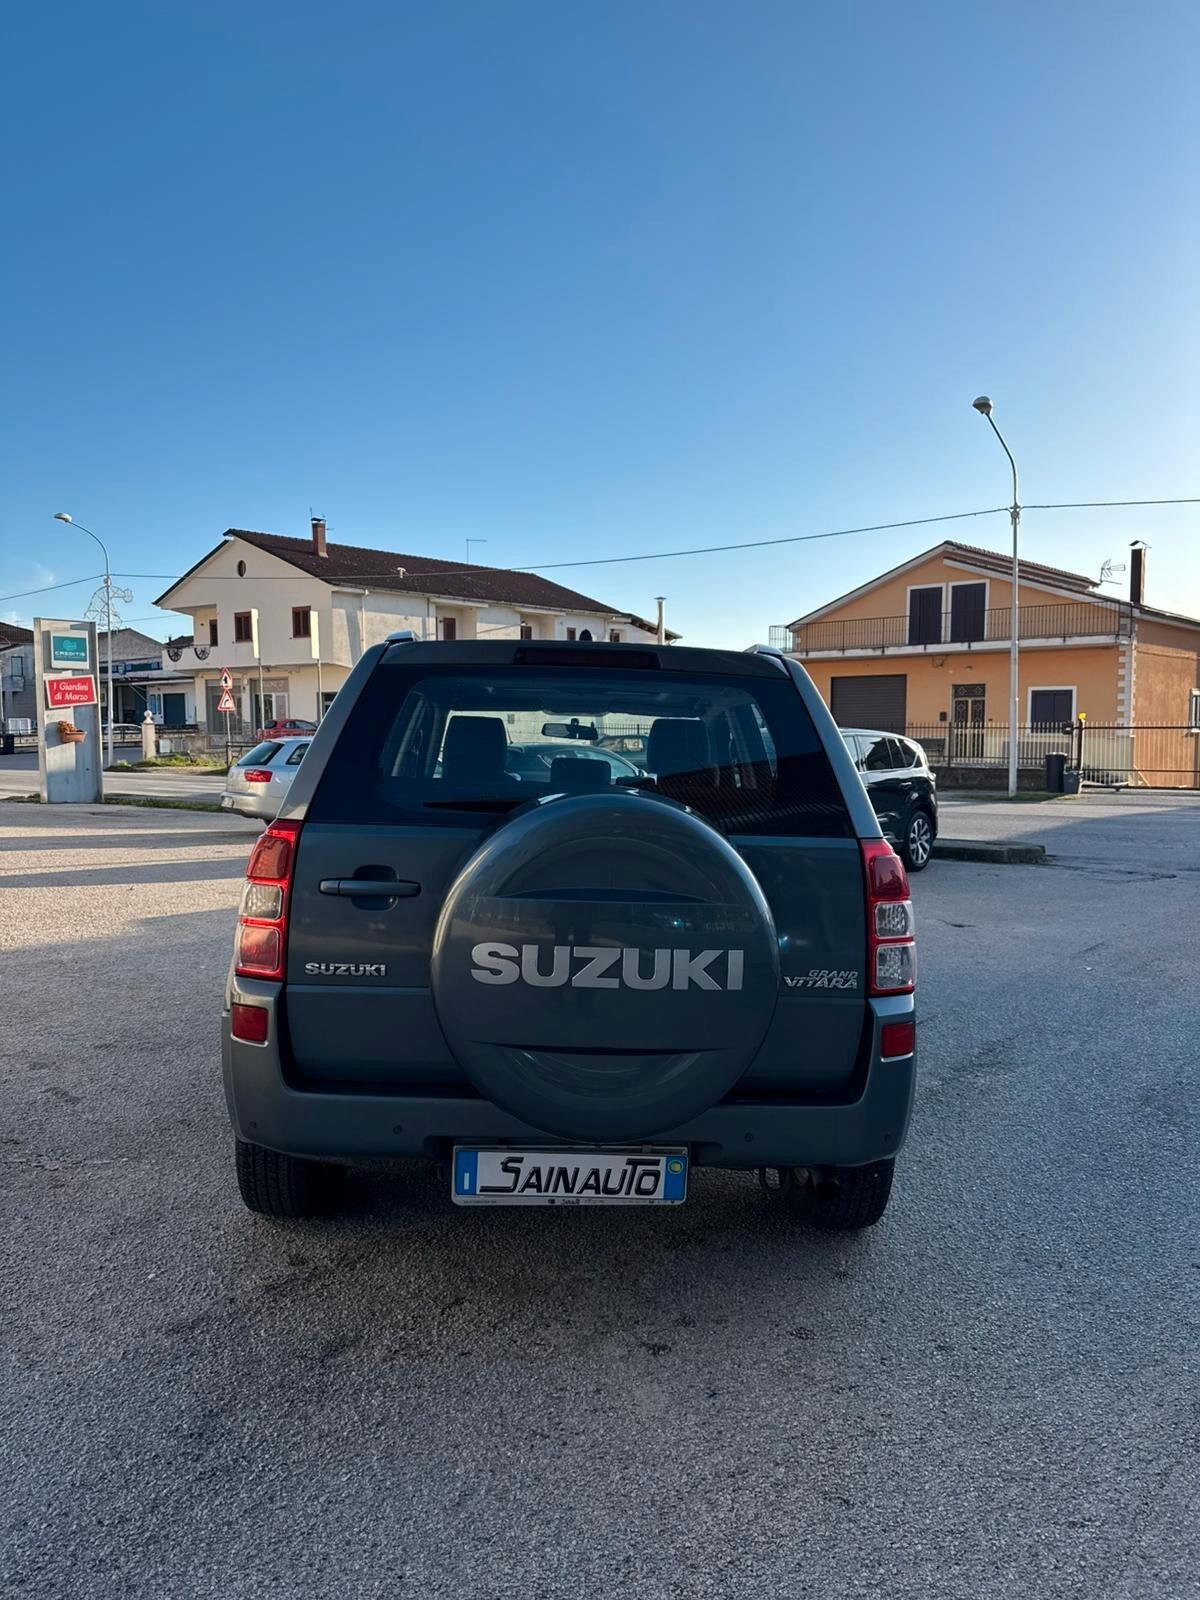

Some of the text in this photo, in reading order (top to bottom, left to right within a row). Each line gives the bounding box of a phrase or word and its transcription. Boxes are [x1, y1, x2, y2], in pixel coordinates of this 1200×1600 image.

[59, 682, 88, 691] Giardini
[65, 692, 88, 701] Marzo
[305, 962, 386, 976] SUZUKI
[471, 942, 744, 990] SUZUKI
[808, 969, 858, 980] GRAND
[783, 976, 858, 989] VITARA
[479, 1156, 661, 1196] SAINAUTO
